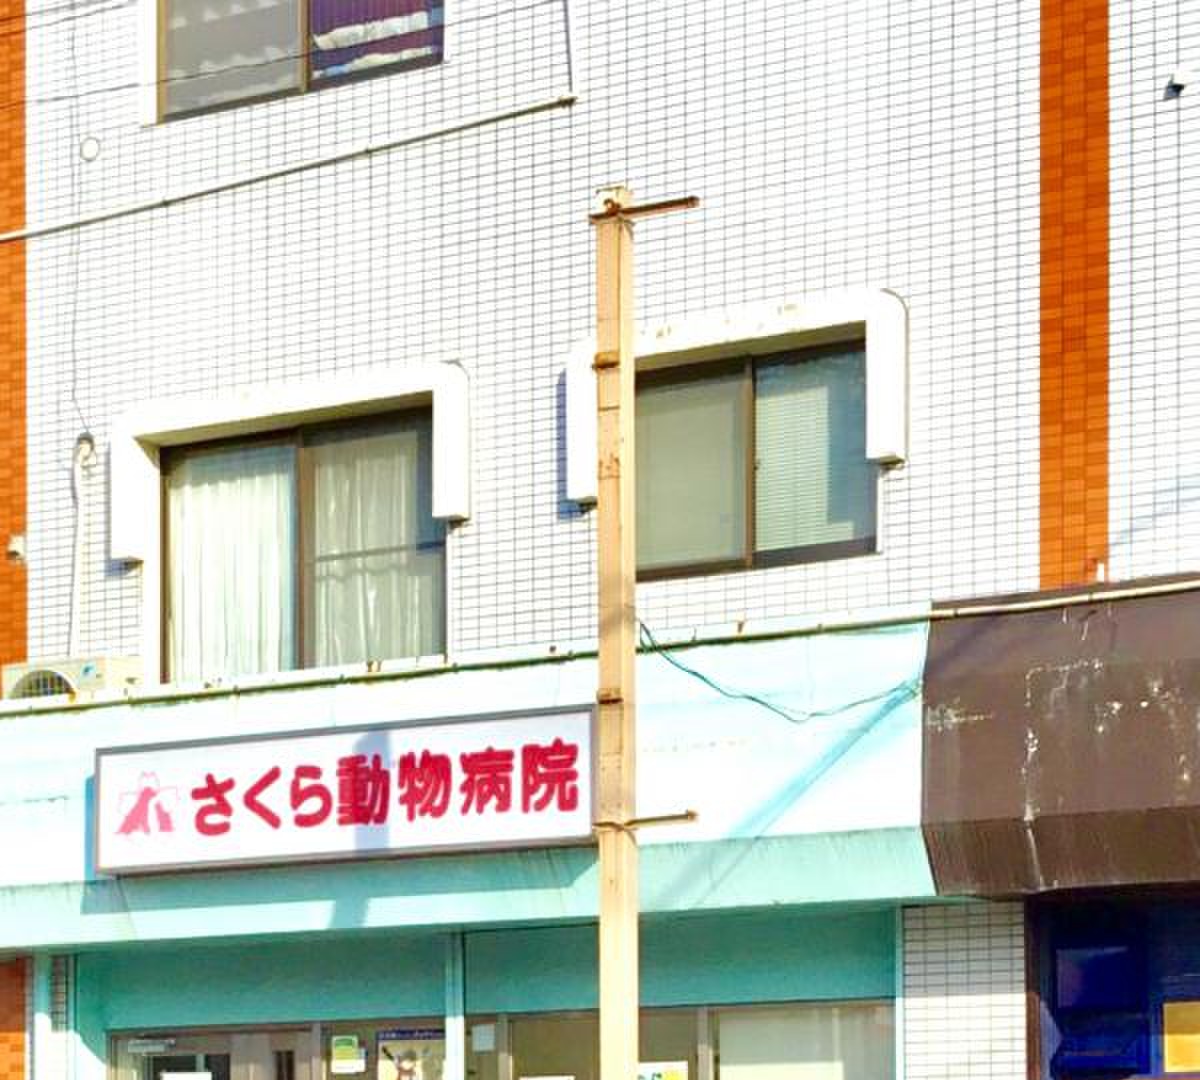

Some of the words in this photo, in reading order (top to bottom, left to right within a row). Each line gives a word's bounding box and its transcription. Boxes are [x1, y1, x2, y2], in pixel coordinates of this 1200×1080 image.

[190, 736, 580, 837] さくら動物病院
